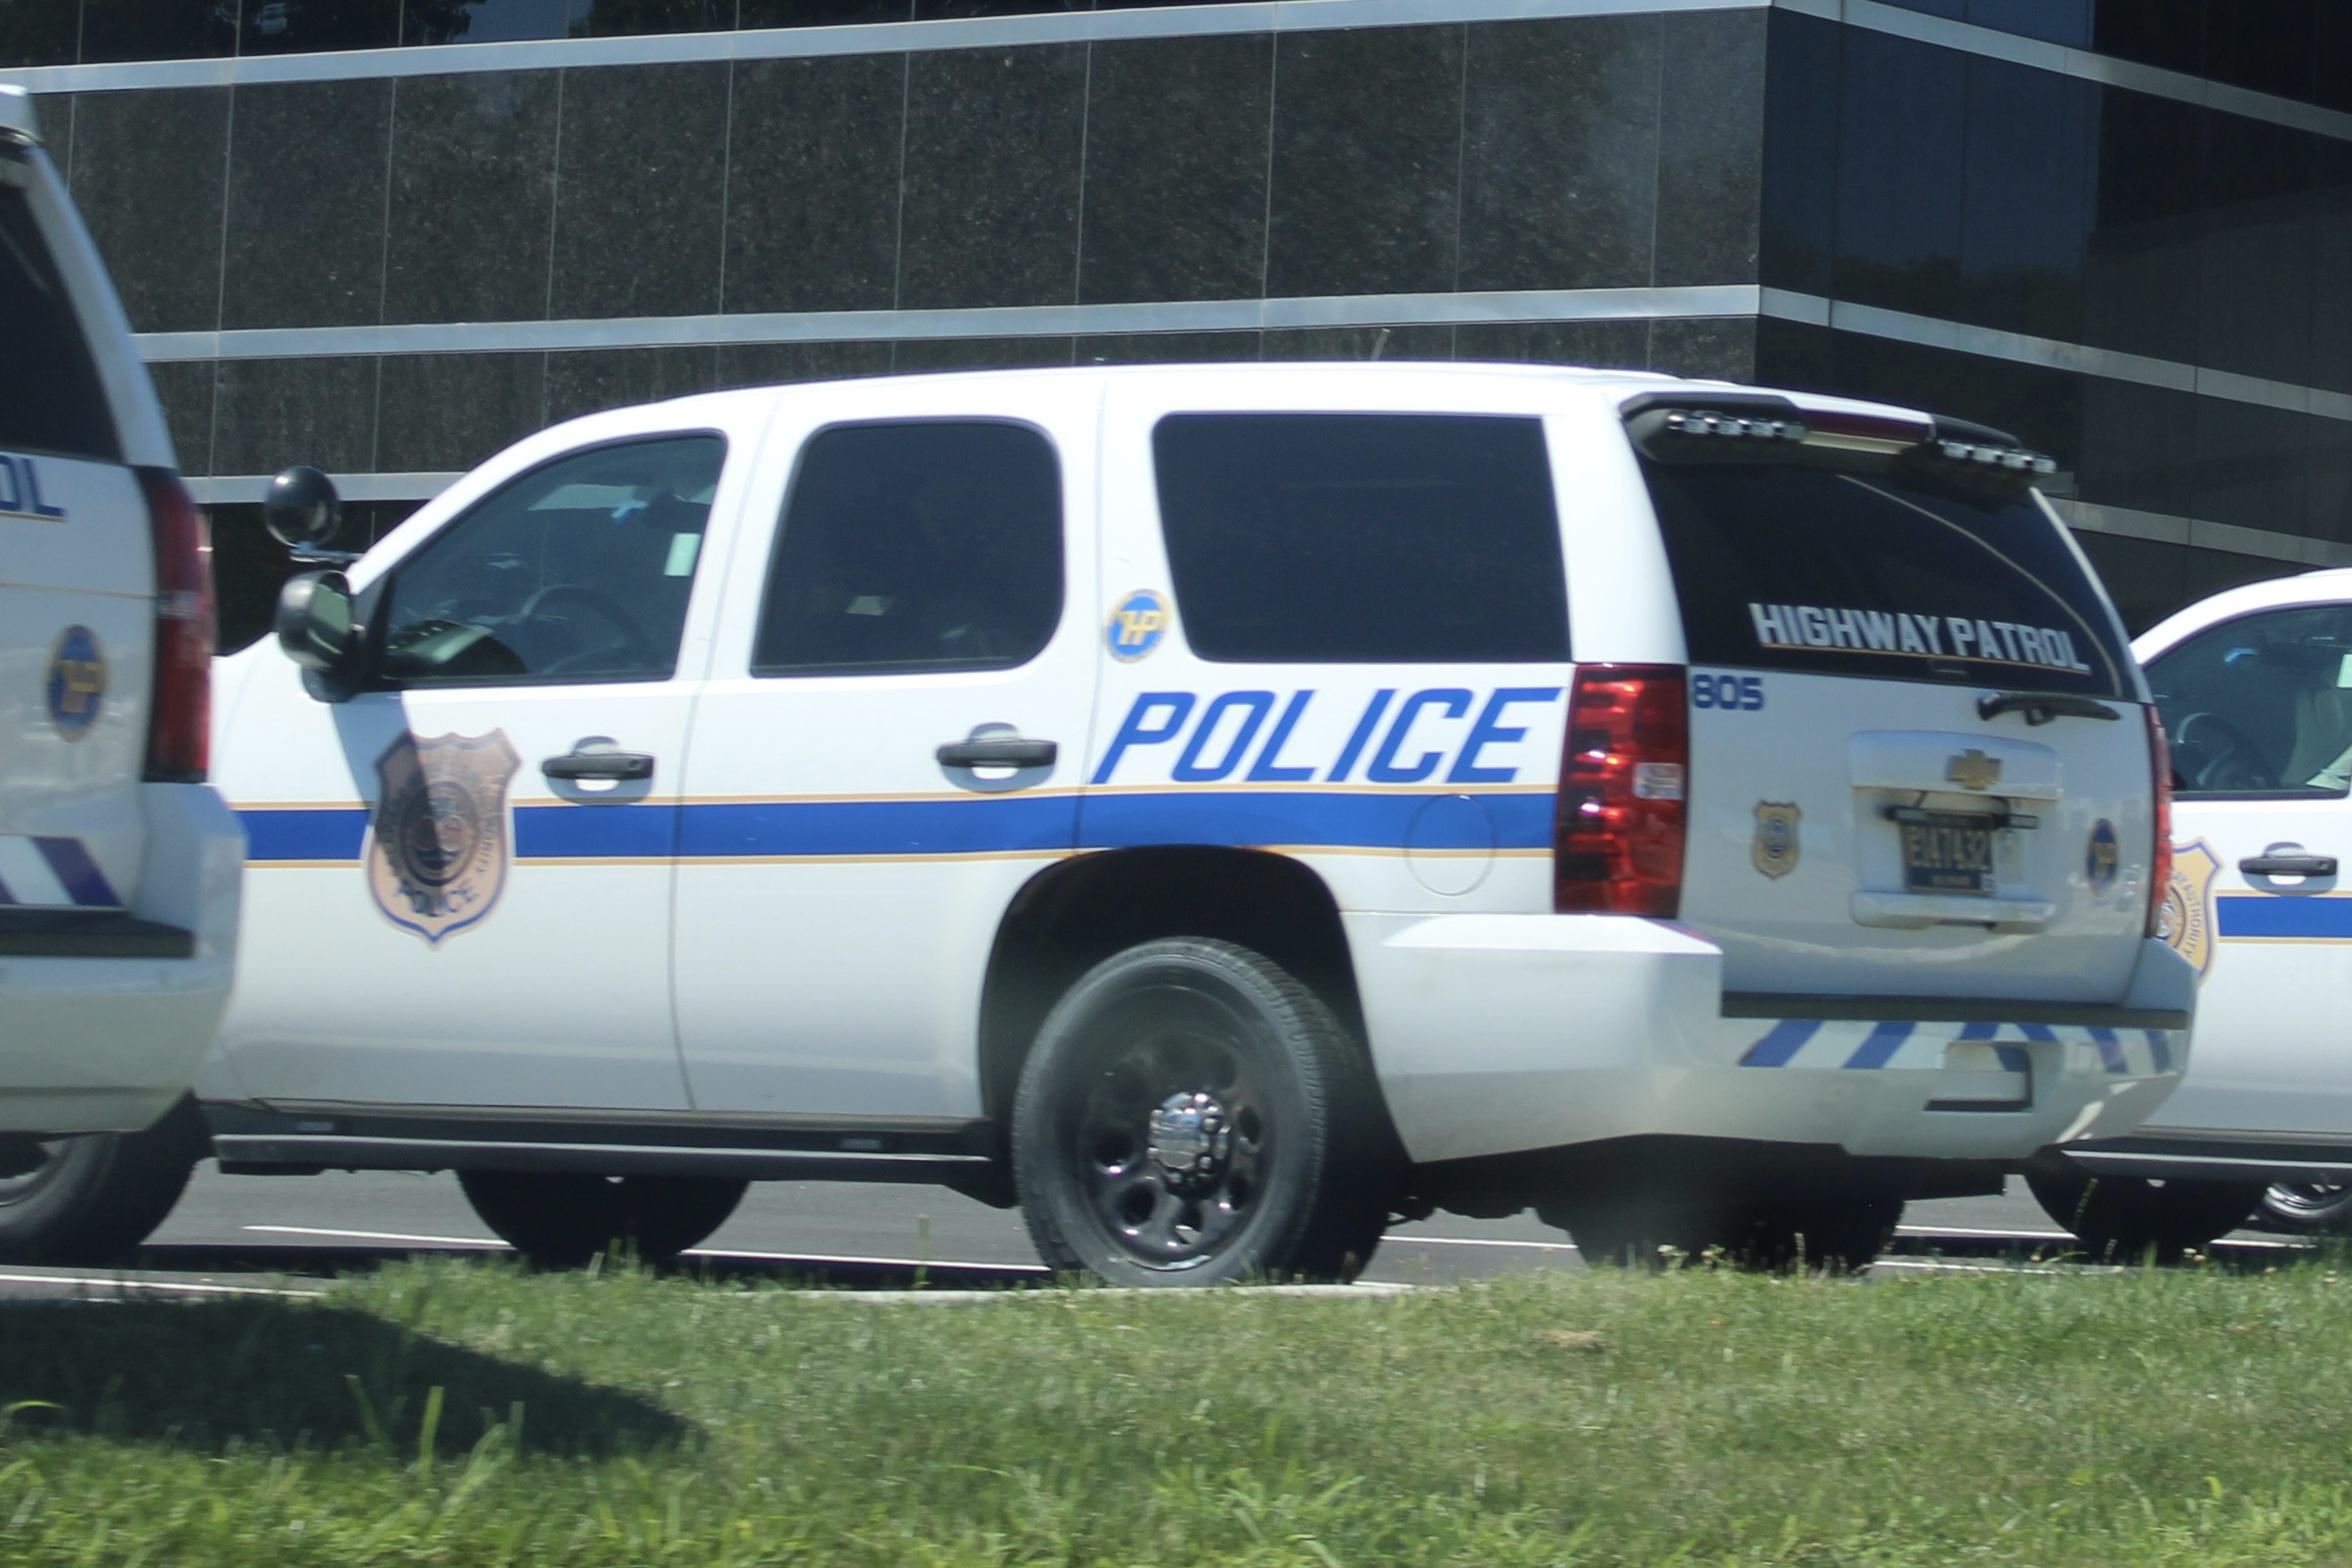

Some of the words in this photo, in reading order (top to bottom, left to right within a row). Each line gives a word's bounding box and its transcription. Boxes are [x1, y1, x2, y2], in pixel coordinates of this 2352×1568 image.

[1748, 602, 1940, 655] HIGHWAY
[1946, 617, 2090, 672] PATROL
[1693, 673, 1764, 711] 805
[1089, 686, 1564, 785] POLICE
